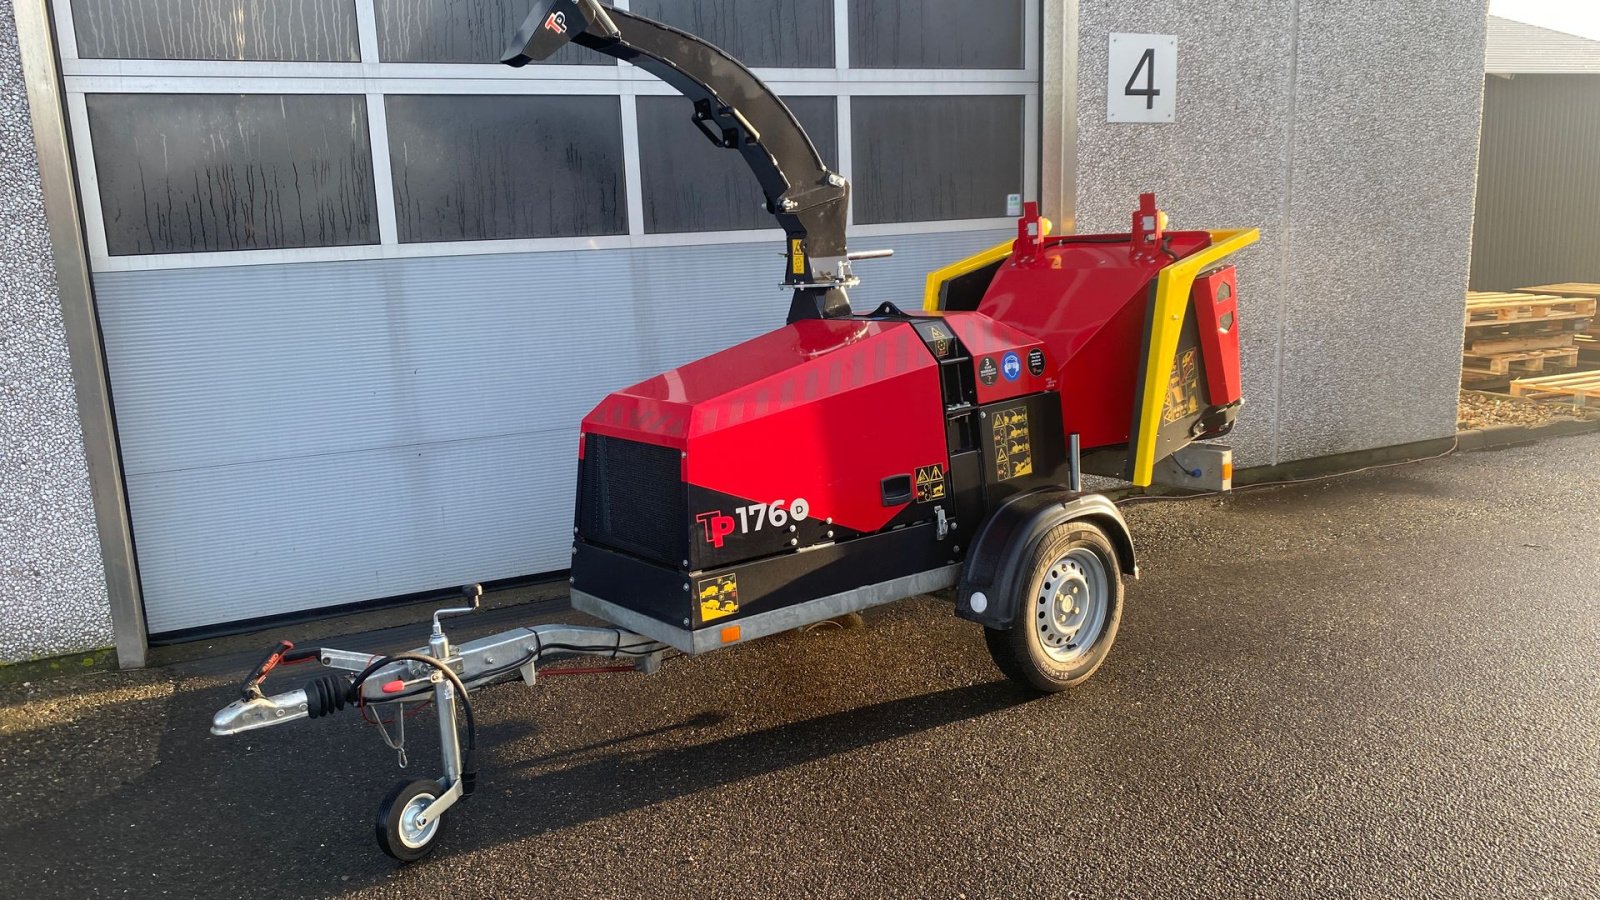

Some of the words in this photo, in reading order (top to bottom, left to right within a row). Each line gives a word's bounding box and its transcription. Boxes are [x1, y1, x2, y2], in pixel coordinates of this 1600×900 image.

[545, 11, 567, 34] TP
[1125, 48, 1160, 110] 4
[696, 510, 735, 548] TP
[735, 499, 788, 534] 176
